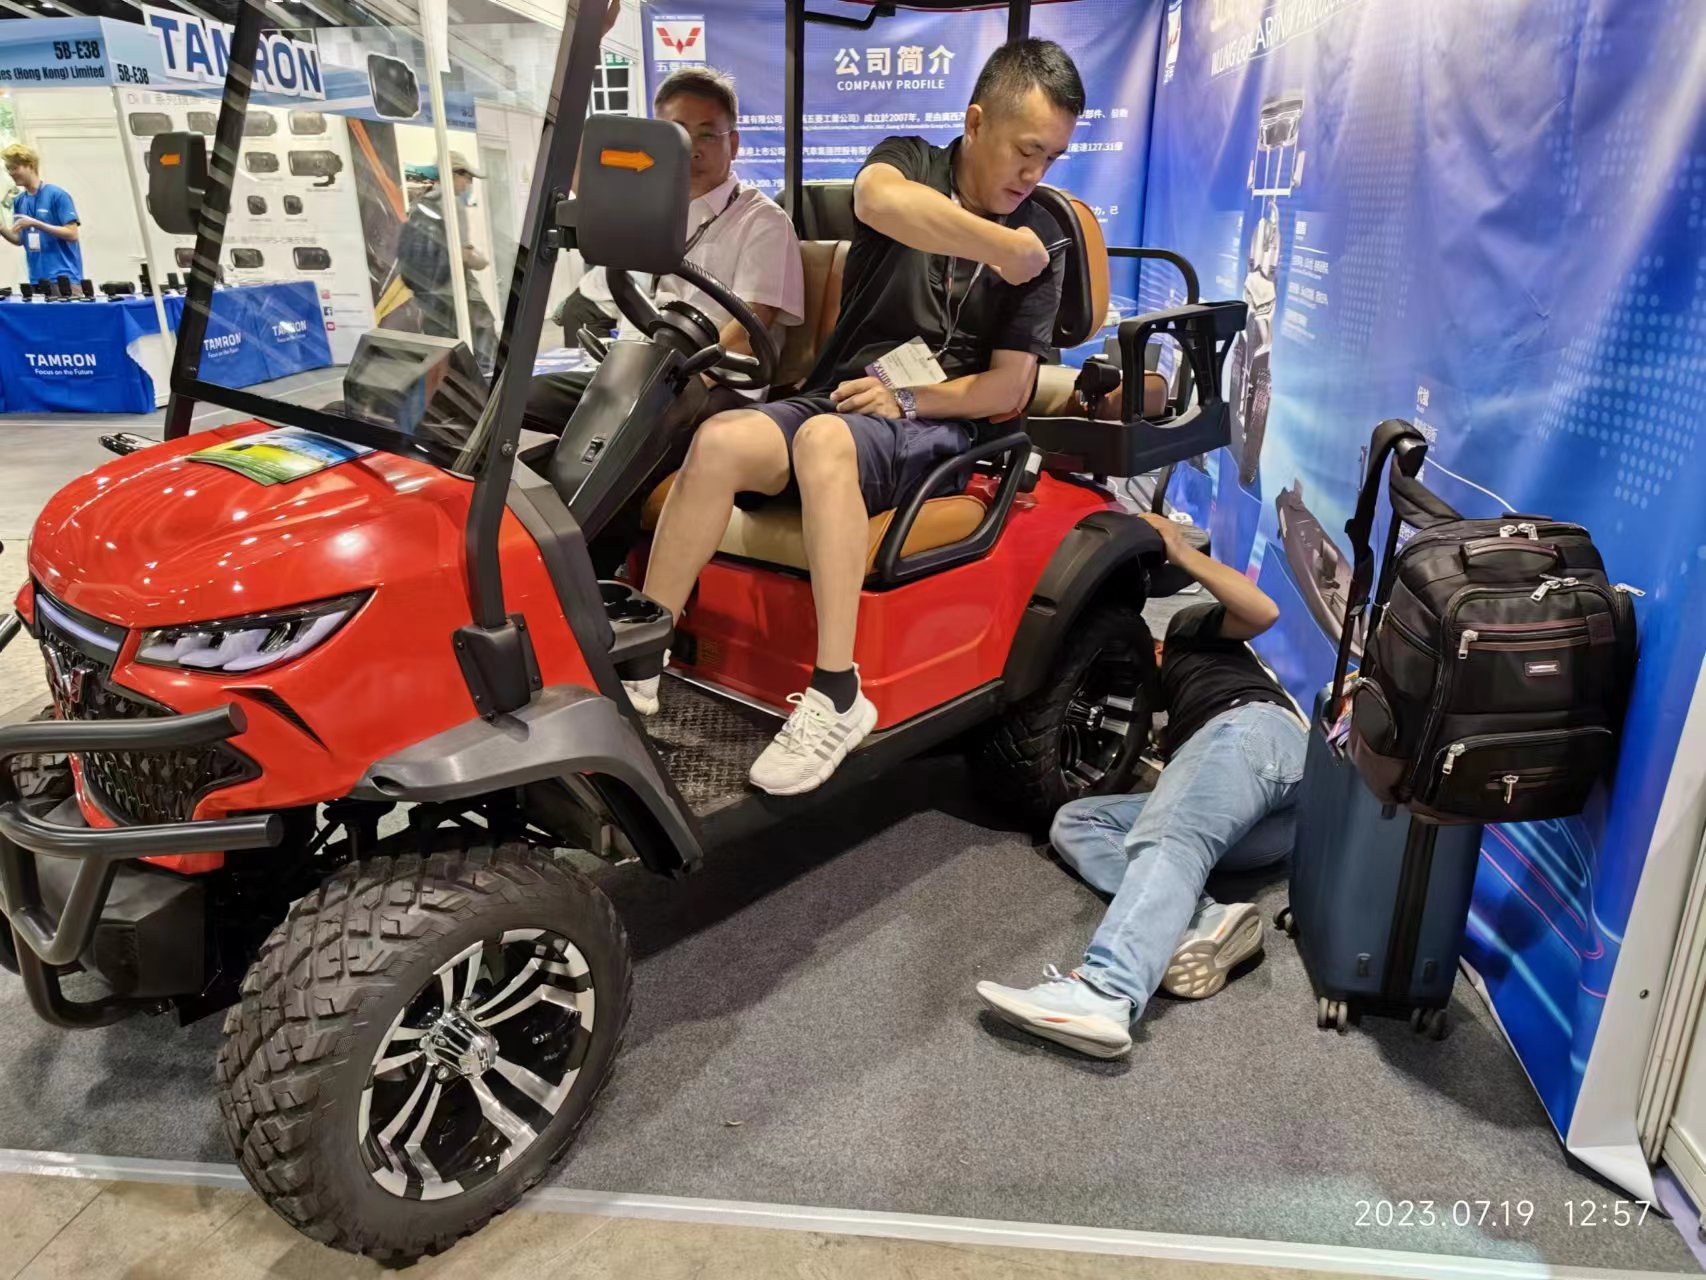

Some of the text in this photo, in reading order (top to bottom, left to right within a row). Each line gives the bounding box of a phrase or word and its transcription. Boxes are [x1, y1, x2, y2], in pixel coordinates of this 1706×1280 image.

[53, 41, 101, 60] 5B-E38
[834, 45, 956, 76] 公司簡介
[13, 67, 41, 81] (Hong
[41, 65, 69, 80] Kong)
[70, 65, 105, 79] Limited
[117, 64, 150, 84] 5B-E38
[837, 80, 945, 91] COMPANY PROFILE
[203, 332, 242, 351] TAMRON
[25, 353, 97, 367] TAMRON
[73, 368, 94, 376] Future
